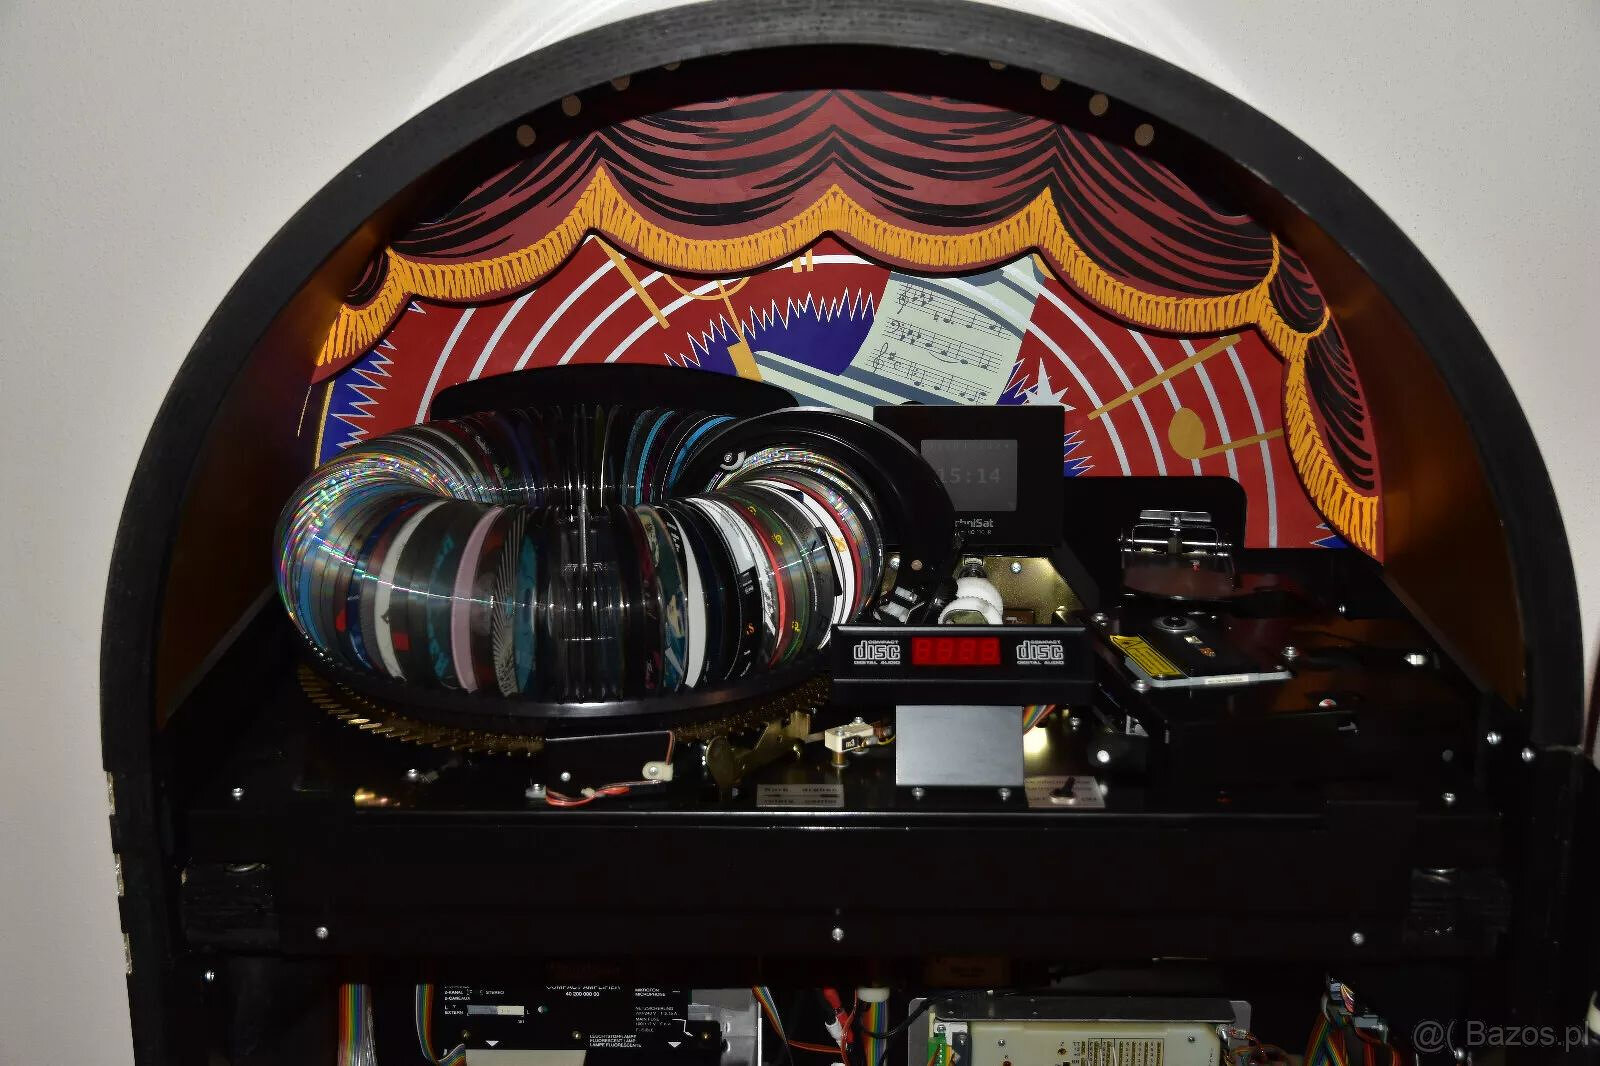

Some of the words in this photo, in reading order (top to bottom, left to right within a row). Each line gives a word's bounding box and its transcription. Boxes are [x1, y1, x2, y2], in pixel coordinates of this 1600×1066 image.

[937, 467, 1001, 484] 15:14
[853, 640, 901, 660] disc
[1016, 640, 1064, 660] disc
